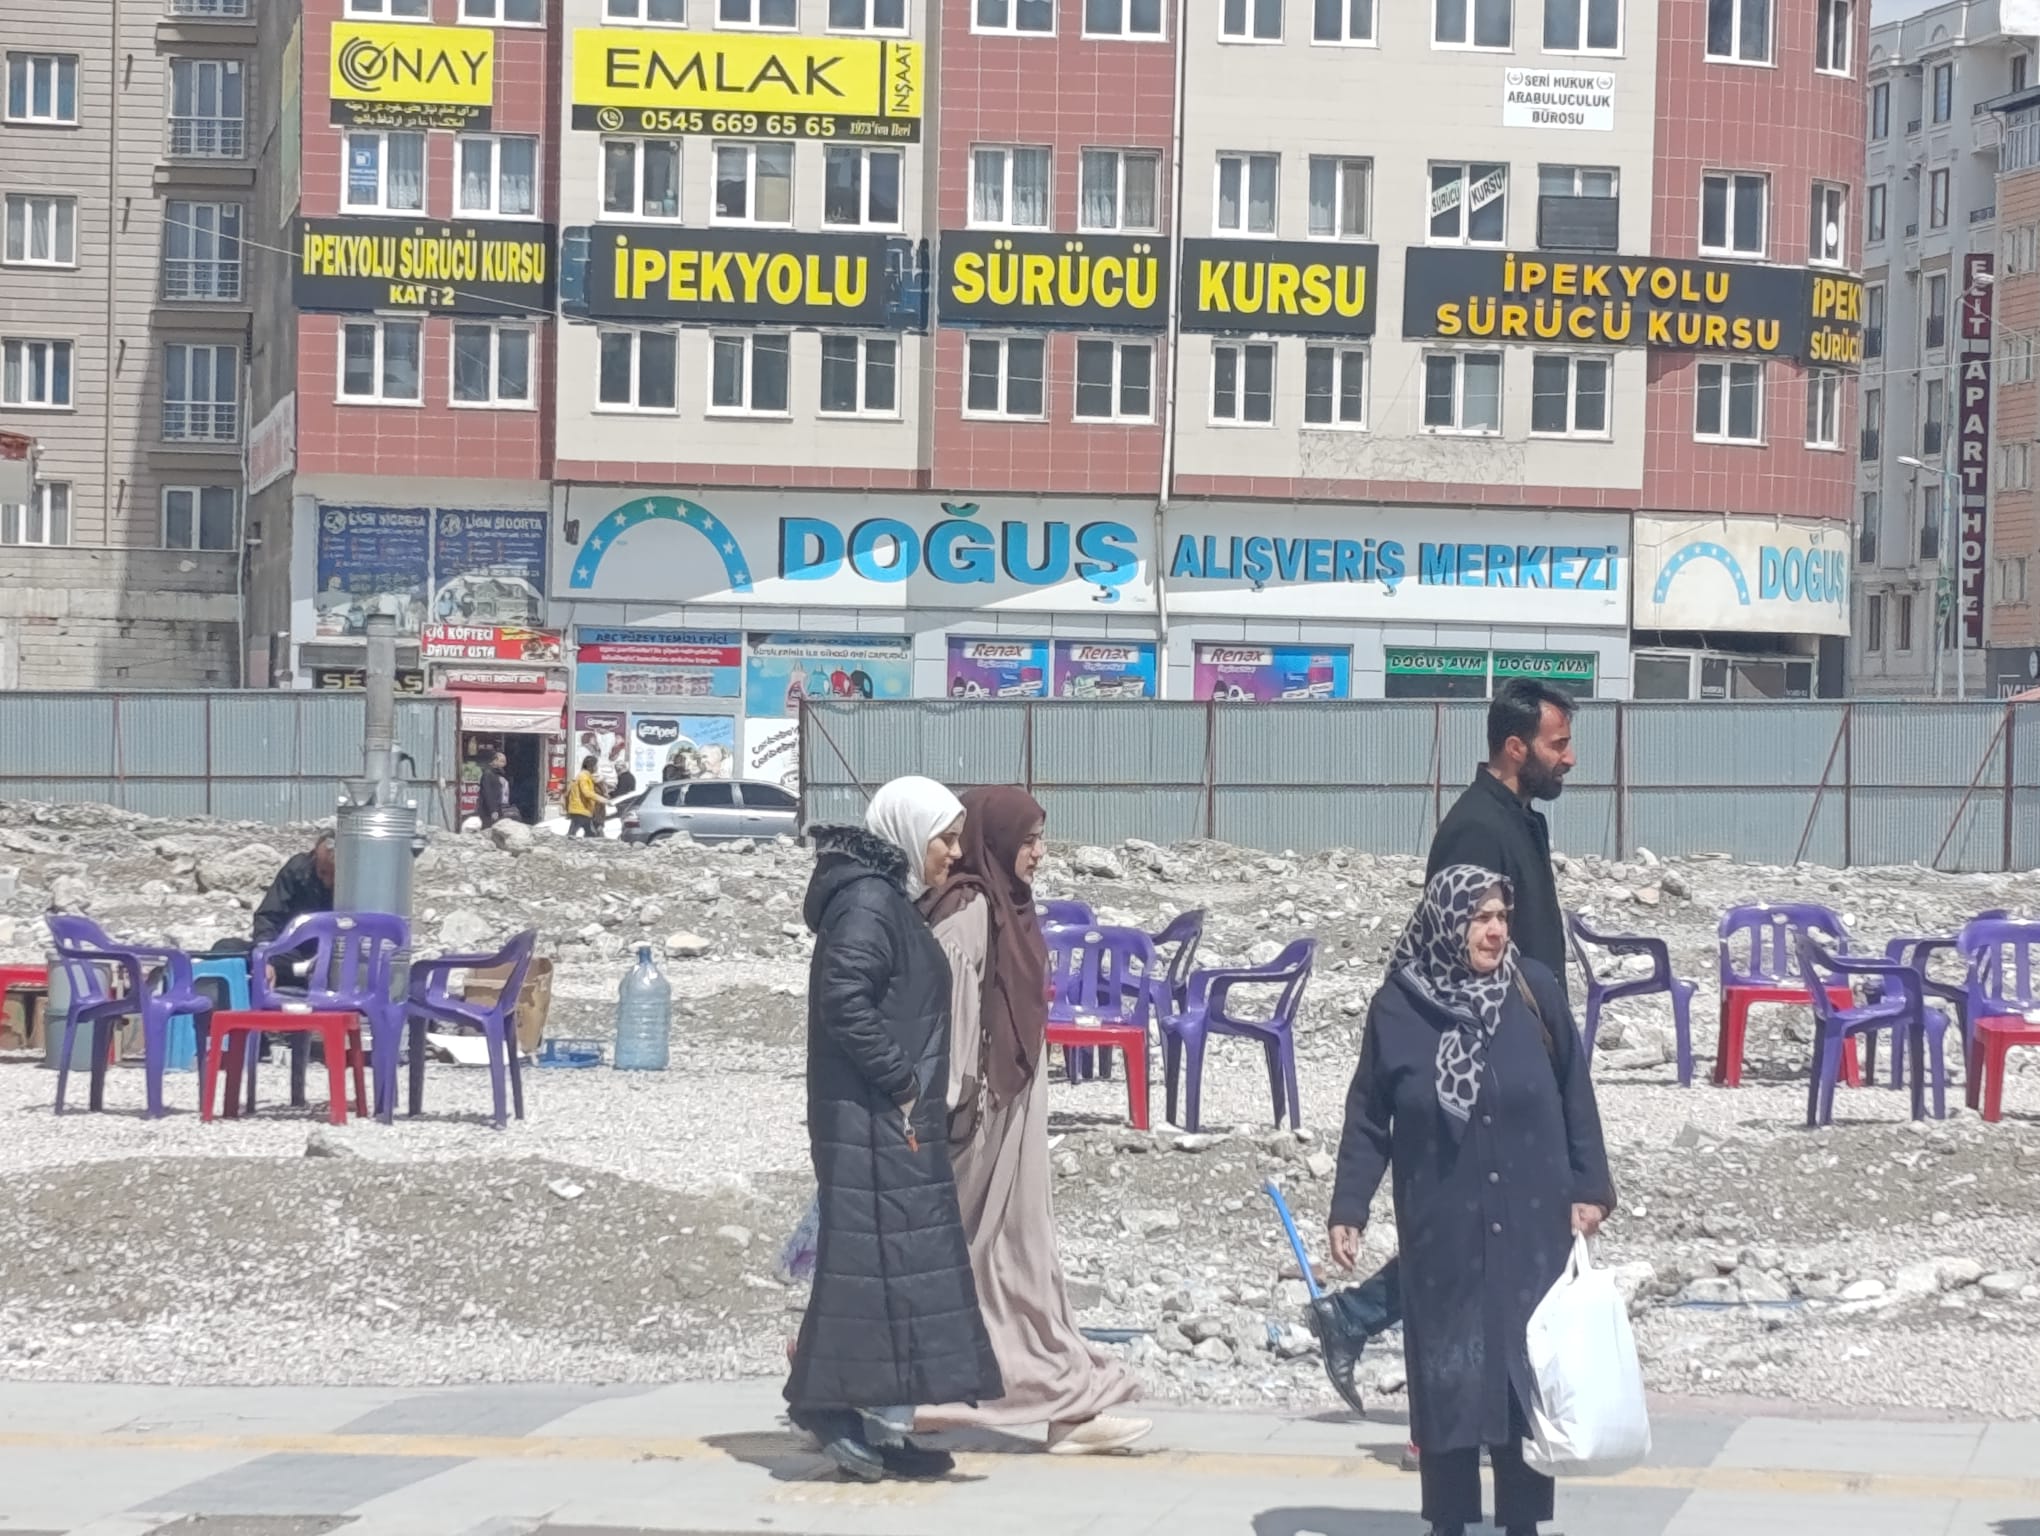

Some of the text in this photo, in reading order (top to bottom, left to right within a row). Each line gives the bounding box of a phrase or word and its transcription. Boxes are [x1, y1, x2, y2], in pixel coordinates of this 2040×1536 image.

[339, 36, 488, 93] ONAY
[607, 48, 845, 97] EMLAK
[1524, 73, 1594, 89] SERİ HUKUK
[1508, 91, 1610, 107] ARABULUCULUK
[1532, 109, 1584, 125] BÜROSU
[641, 110, 836, 137] 0545 669 65 65
[1431, 172, 1503, 213] SÜRÜCÜ KURSU
[303, 223, 545, 284] İPEKYOLU SÜRÜCÜ KURSU
[614, 234, 867, 307] İPEKYOLU
[952, 239, 1158, 309] SÜRÜCÜ
[389, 285, 426, 304] KAT
[441, 287, 455, 306] 2
[1198, 259, 1366, 317] KURSU
[1504, 253, 1730, 303] İPEKYOLU
[1436, 296, 1780, 350] SÜRÜCÜ KURSU
[1963, 360, 1986, 487] APART
[778, 502, 1139, 604] DOĞUŞ
[1962, 513, 1981, 647] HOTEL
[426, 644, 496, 659] DAVUT USTA
[971, 643, 1025, 657] Renax
[1078, 646, 1131, 660] Renax
[1210, 648, 1265, 663] Renax
[1450, 656, 1482, 670] AVM
